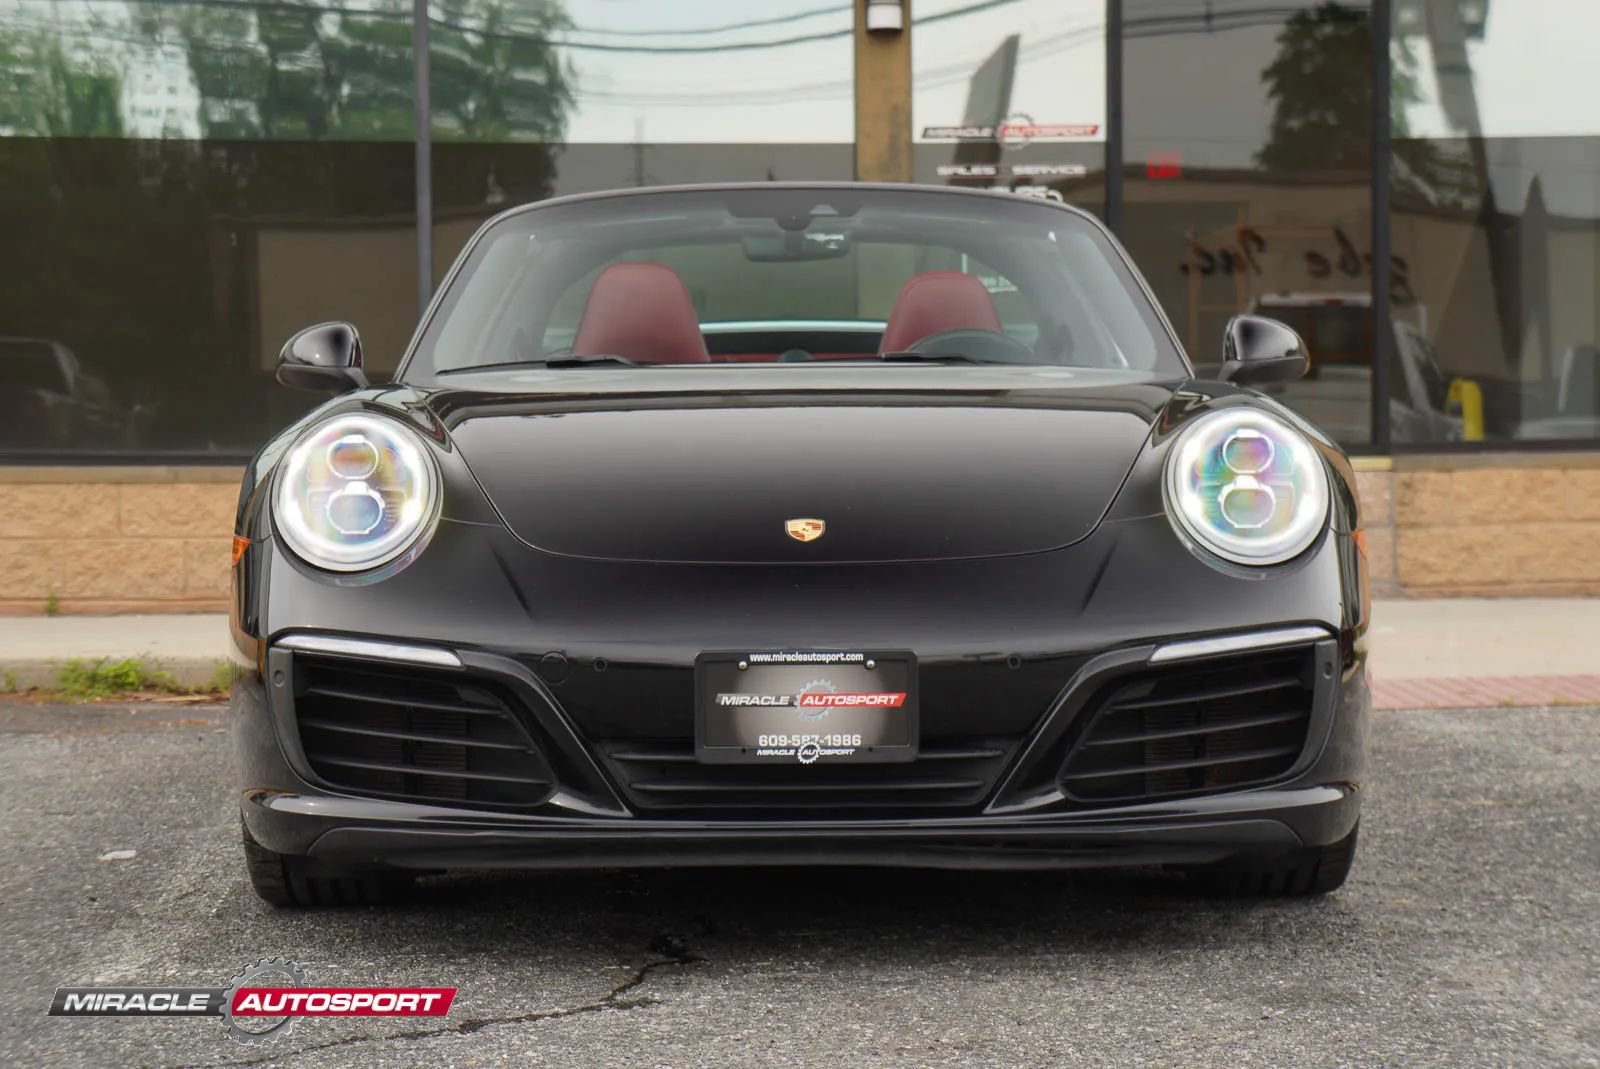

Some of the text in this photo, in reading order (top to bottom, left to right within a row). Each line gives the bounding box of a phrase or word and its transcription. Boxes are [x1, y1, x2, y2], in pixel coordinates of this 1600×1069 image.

[926, 126, 1093, 138] MIRACLE AUTOSPORT
[936, 164, 1087, 176] SALES SERVICE
[749, 652, 864, 664] www.miracleautosport.com
[720, 694, 899, 706] MIRACLE AUTOSPORT
[758, 734, 862, 747] 609-587-1986
[756, 748, 856, 756] MIRACLE AUTOSPORT
